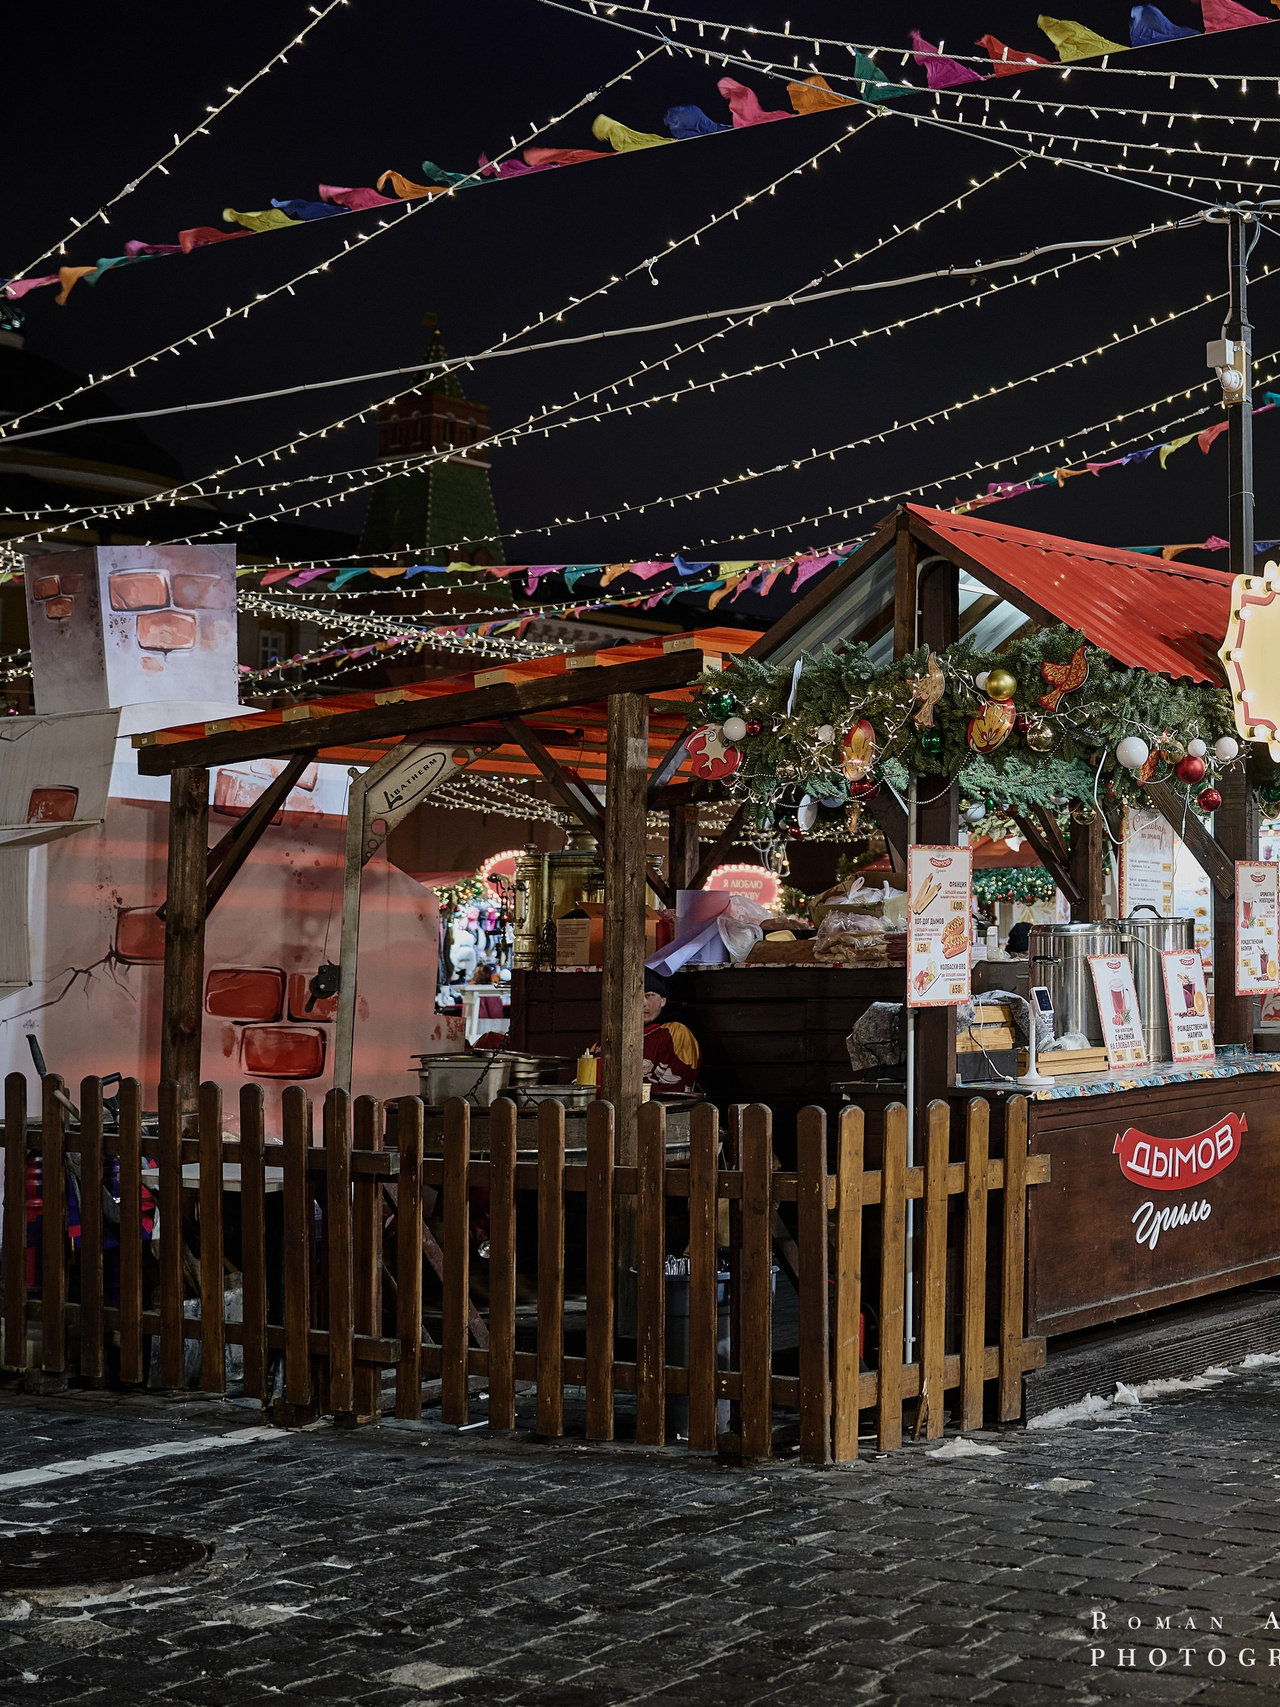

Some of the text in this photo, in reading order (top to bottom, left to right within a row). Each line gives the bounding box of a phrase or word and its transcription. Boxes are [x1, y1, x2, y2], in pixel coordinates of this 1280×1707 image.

[384, 758, 437, 809] LIBATHERM
[723, 879, 763, 889] Я ЛЮБЛЮ
[1126, 1124, 1234, 1179] ДЫМОВ
[1131, 1198, 1212, 1251] Гриль
